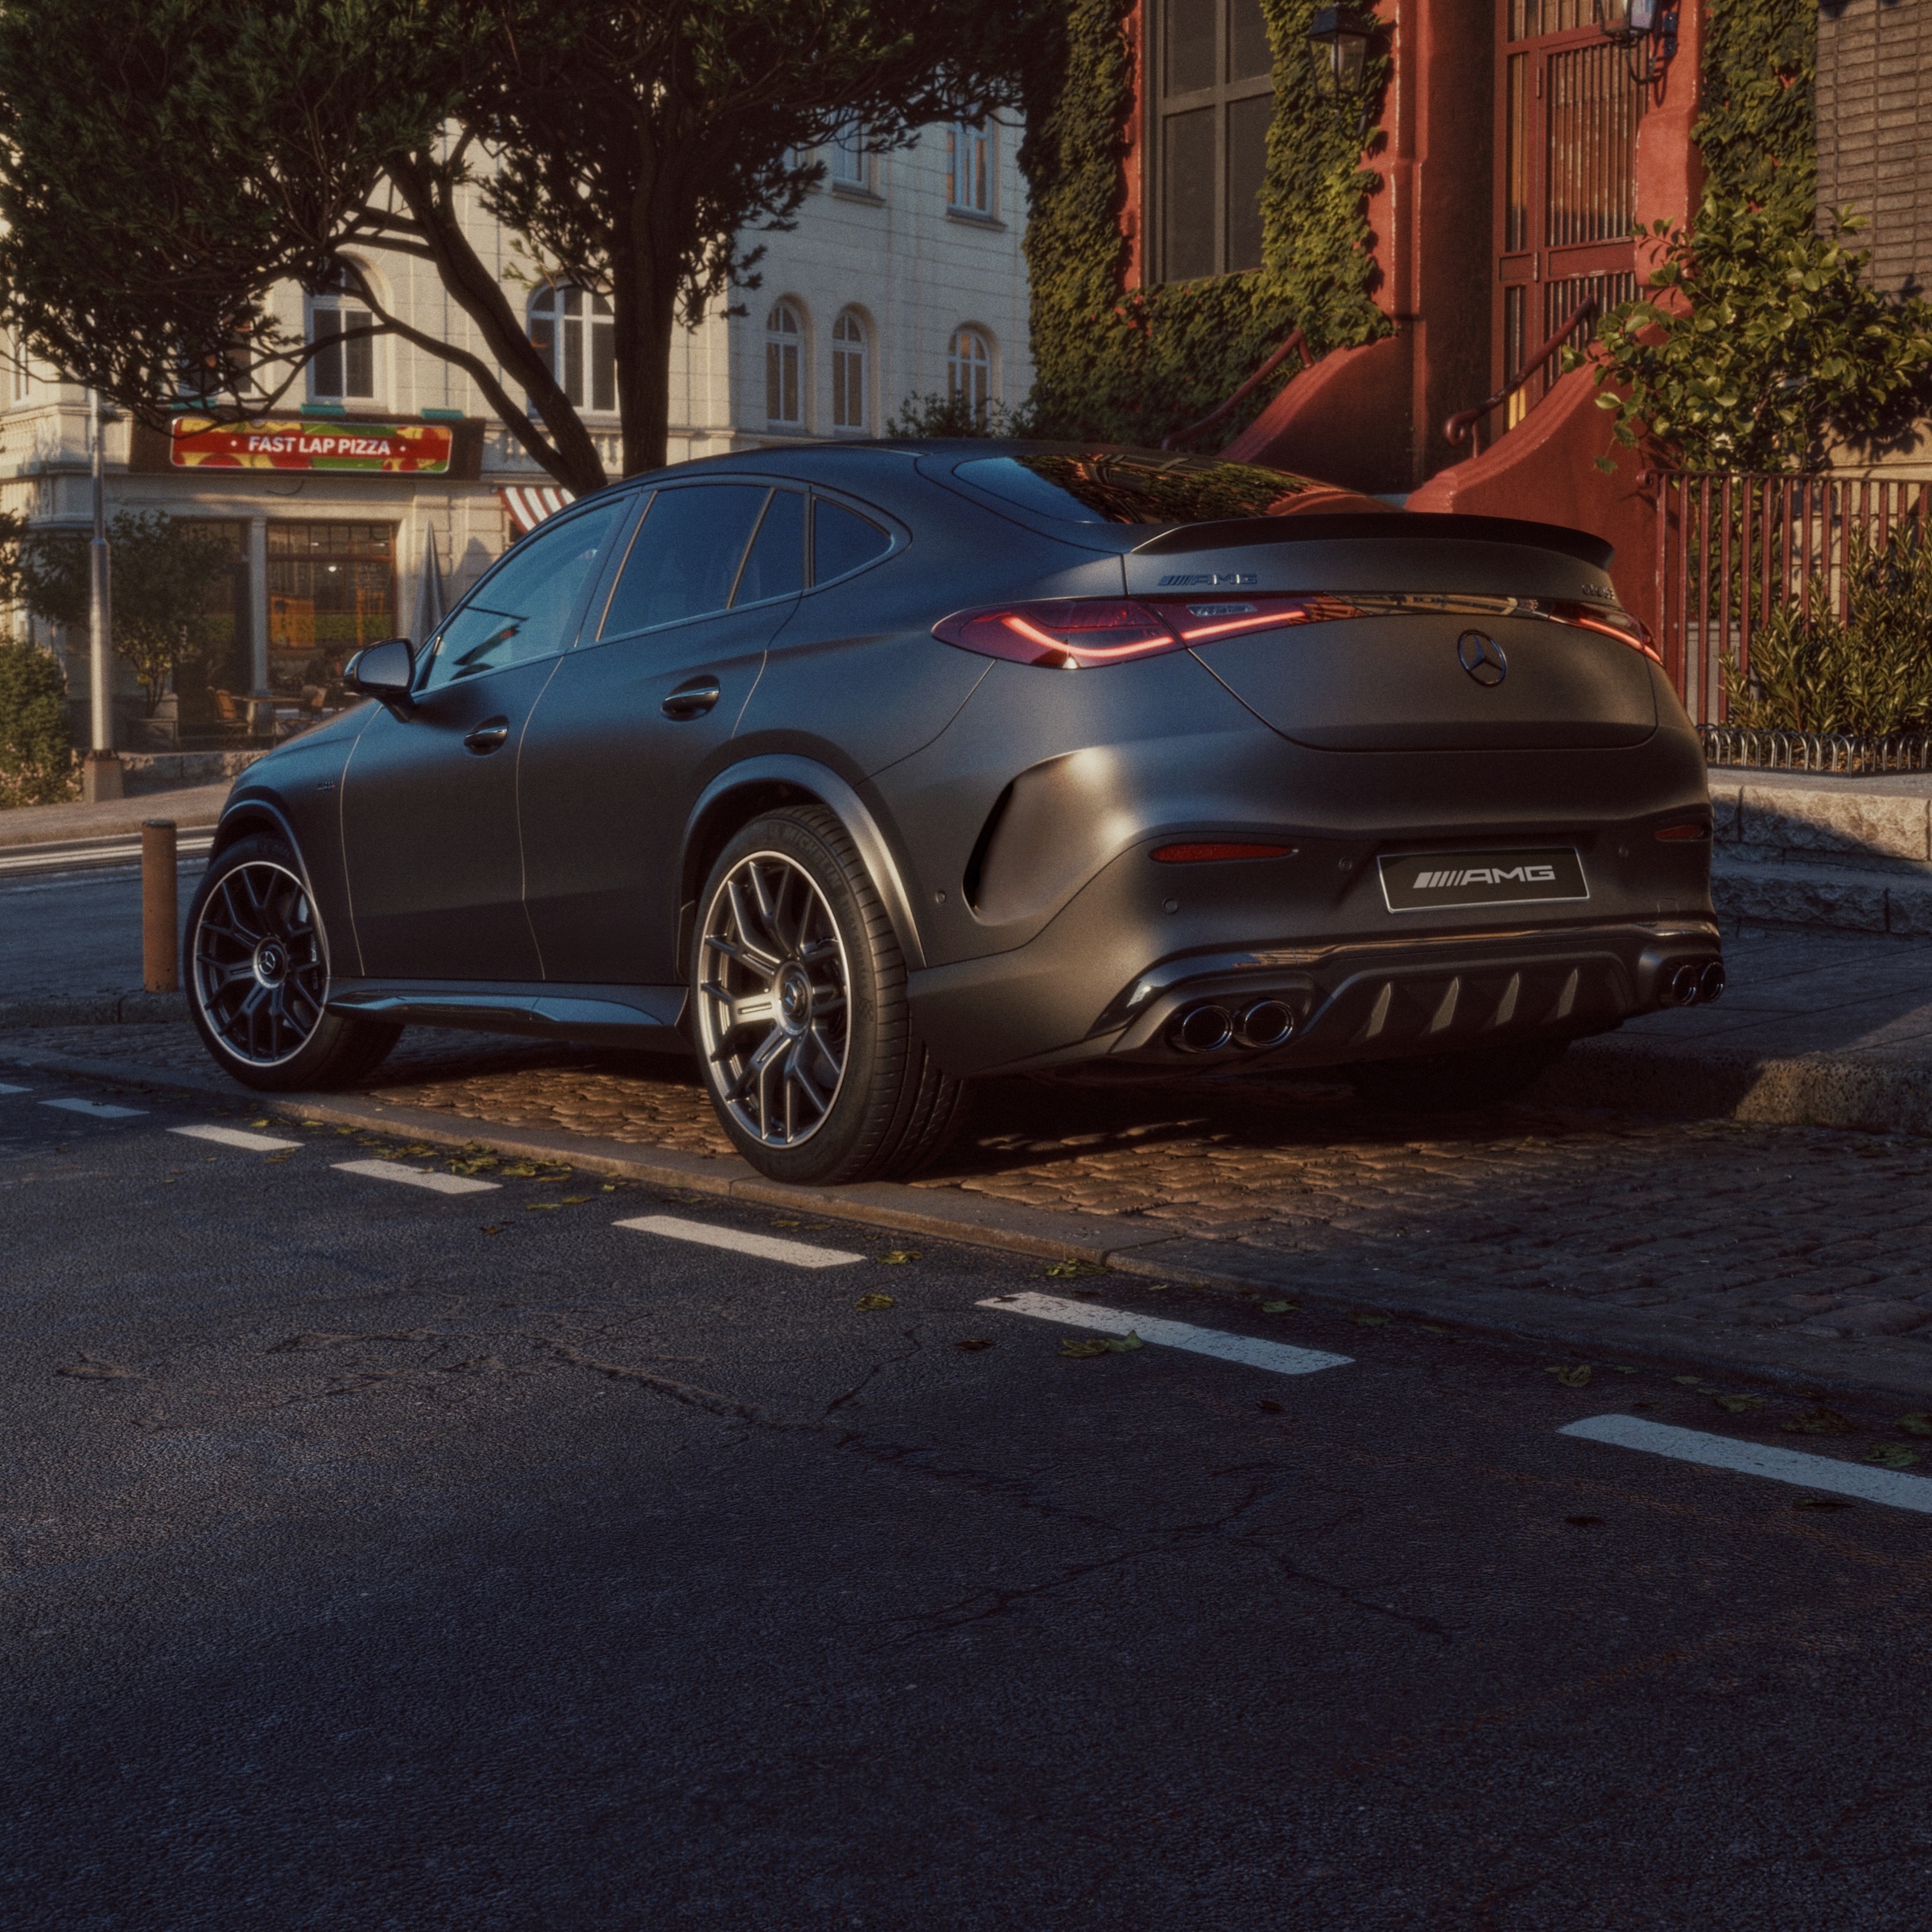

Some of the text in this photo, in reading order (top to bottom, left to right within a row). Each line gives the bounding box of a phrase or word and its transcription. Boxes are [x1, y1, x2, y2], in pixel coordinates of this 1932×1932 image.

[249, 436, 390, 456] FAST LAP PIZZA
[1191, 574, 1258, 585] AMG
[1460, 865, 1556, 886] AMG
